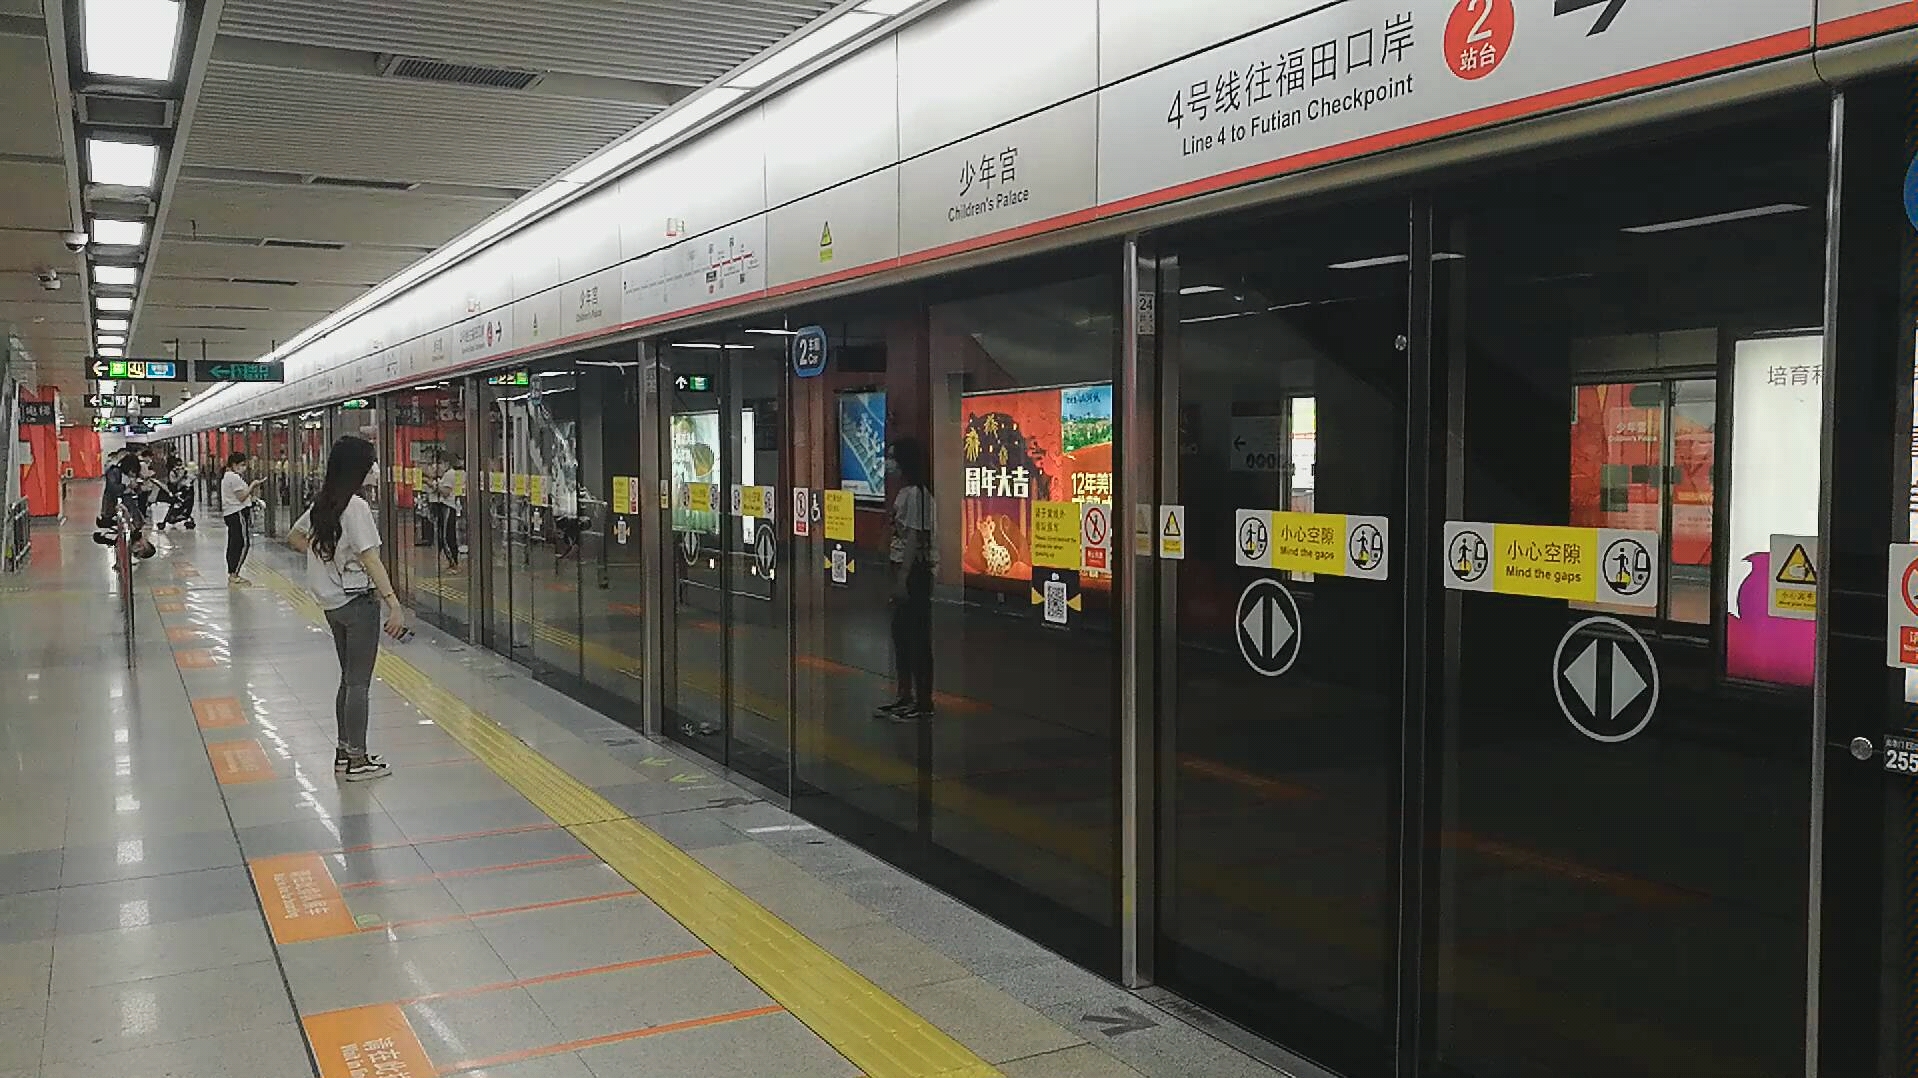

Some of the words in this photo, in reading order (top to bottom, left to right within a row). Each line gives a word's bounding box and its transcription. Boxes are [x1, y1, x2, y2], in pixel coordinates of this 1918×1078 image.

[1467, 0, 1493, 43] 2
[1167, 11, 1415, 130] 4号线往福田口岸
[1460, 42, 1496, 71] 站台
[1183, 135, 1213, 156] Line
[1217, 127, 1227, 145] 4
[1232, 124, 1246, 142] to
[1251, 108, 1301, 137] Futian
[1307, 74, 1414, 120] Checkpoint
[960, 146, 1018, 197] 少年宫
[948, 197, 994, 222] Children's
[996, 189, 1029, 208] Palace
[799, 338, 808, 366] 2
[1281, 524, 1335, 545] 小心空隙
[1280, 545, 1299, 557] Mind
[1300, 547, 1312, 558] the
[1315, 550, 1335, 560] gaps
[1507, 540, 1581, 565] 小心空隙
[1506, 565, 1531, 578] Mind
[1534, 568, 1551, 580] the
[1554, 571, 1582, 584] gaps
